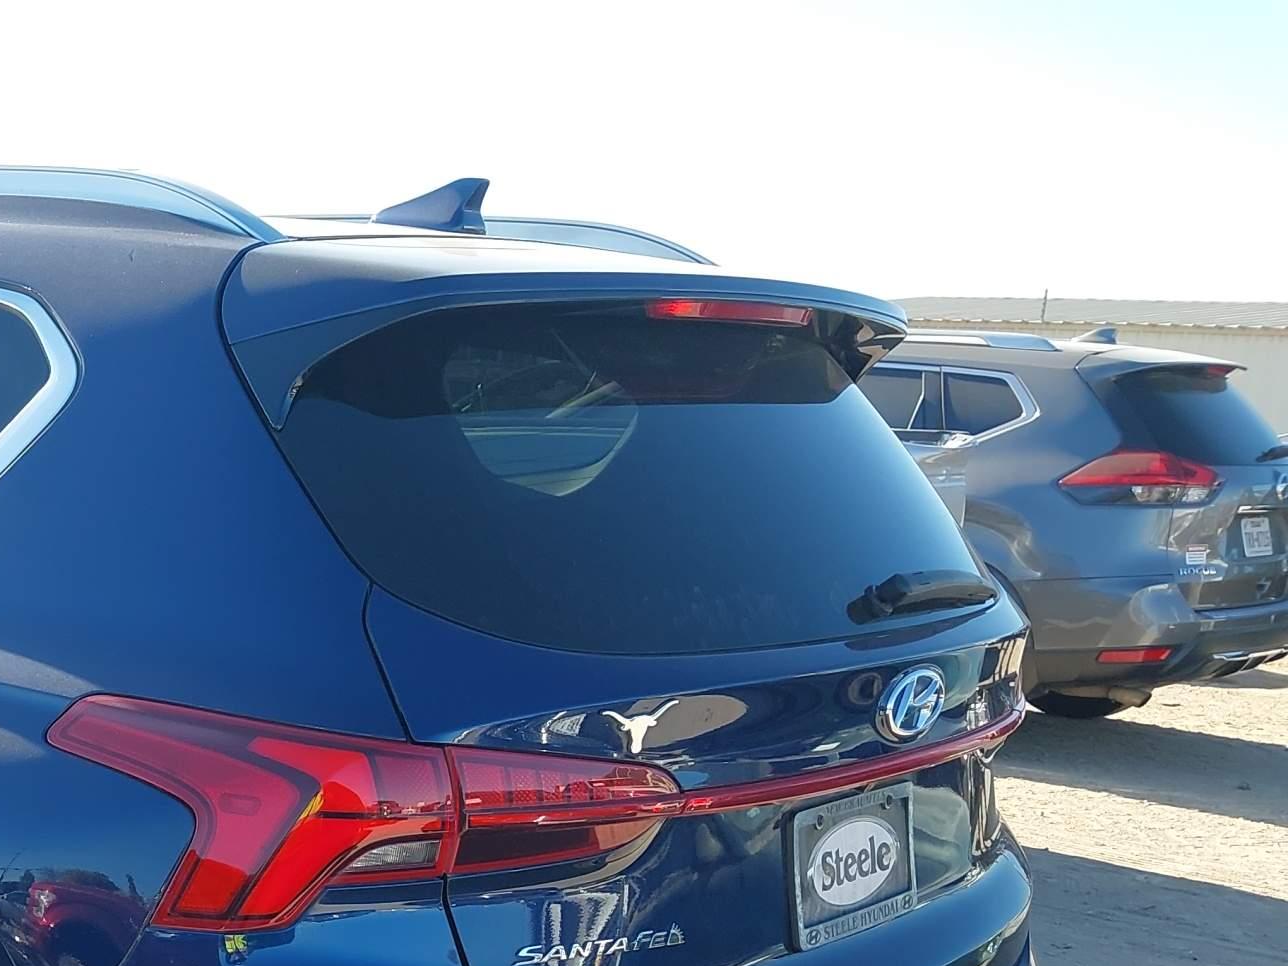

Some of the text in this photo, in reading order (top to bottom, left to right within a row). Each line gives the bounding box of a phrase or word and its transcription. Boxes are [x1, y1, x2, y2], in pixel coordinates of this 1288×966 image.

[821, 835, 891, 892] Steele
[823, 899, 899, 940] STEELE HYUNDAI
